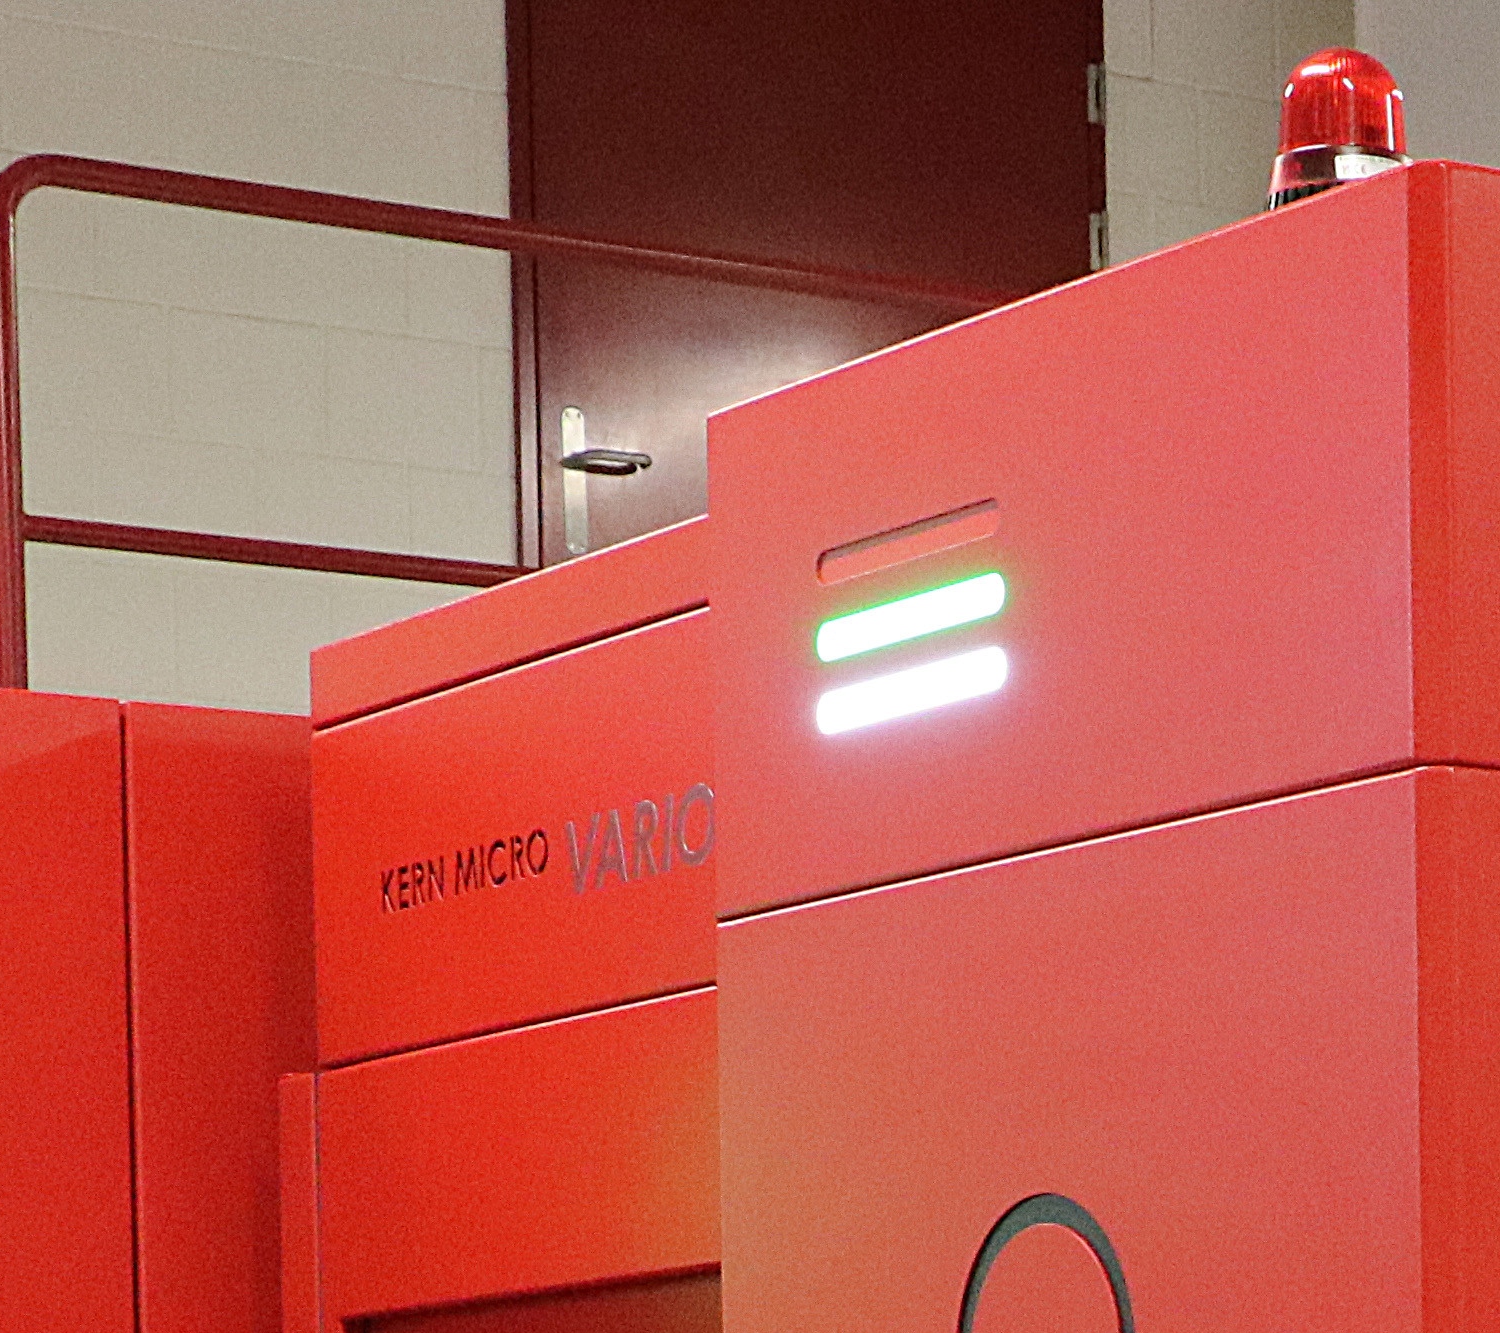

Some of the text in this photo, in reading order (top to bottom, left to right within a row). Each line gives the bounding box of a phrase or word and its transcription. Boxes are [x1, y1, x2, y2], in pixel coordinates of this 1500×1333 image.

[380, 782, 716, 914] KERN MICRO VARIO
